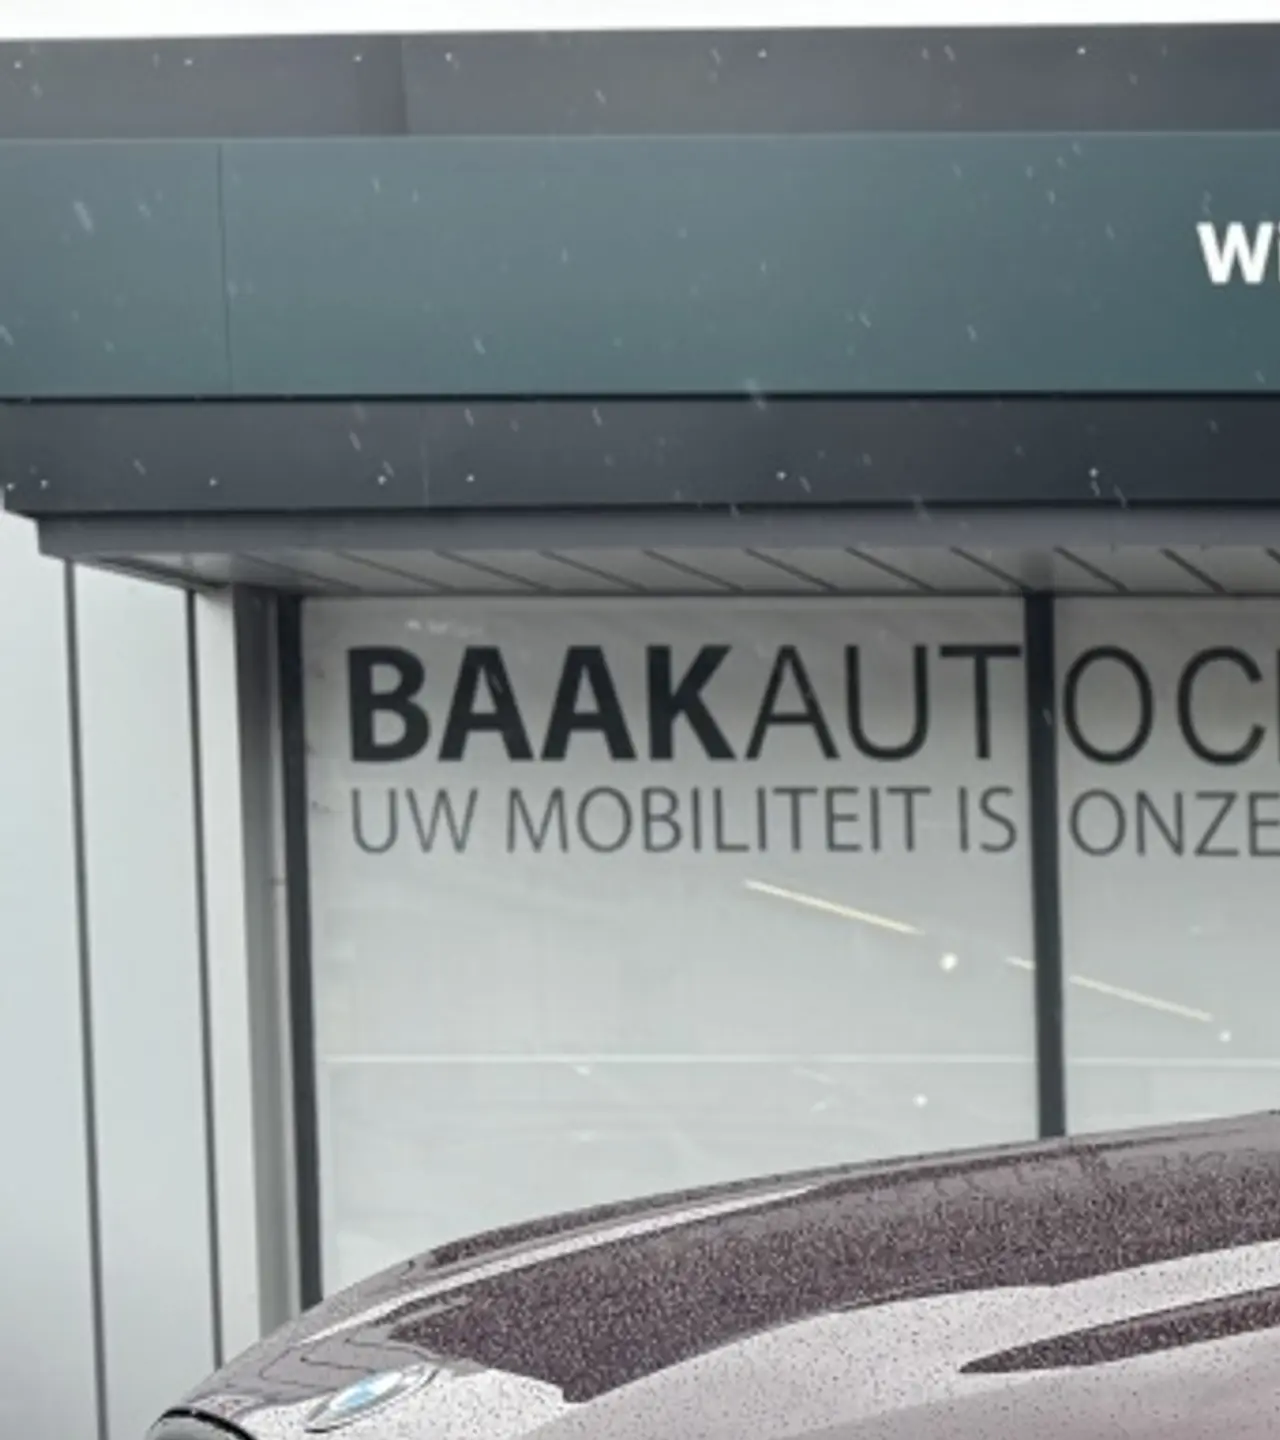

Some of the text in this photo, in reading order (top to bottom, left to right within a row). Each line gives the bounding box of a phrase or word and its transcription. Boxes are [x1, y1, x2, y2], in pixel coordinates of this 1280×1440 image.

[351, 787, 479, 854] UW
[505, 786, 931, 854] MOBILITEIT
[958, 786, 1018, 854] IS
